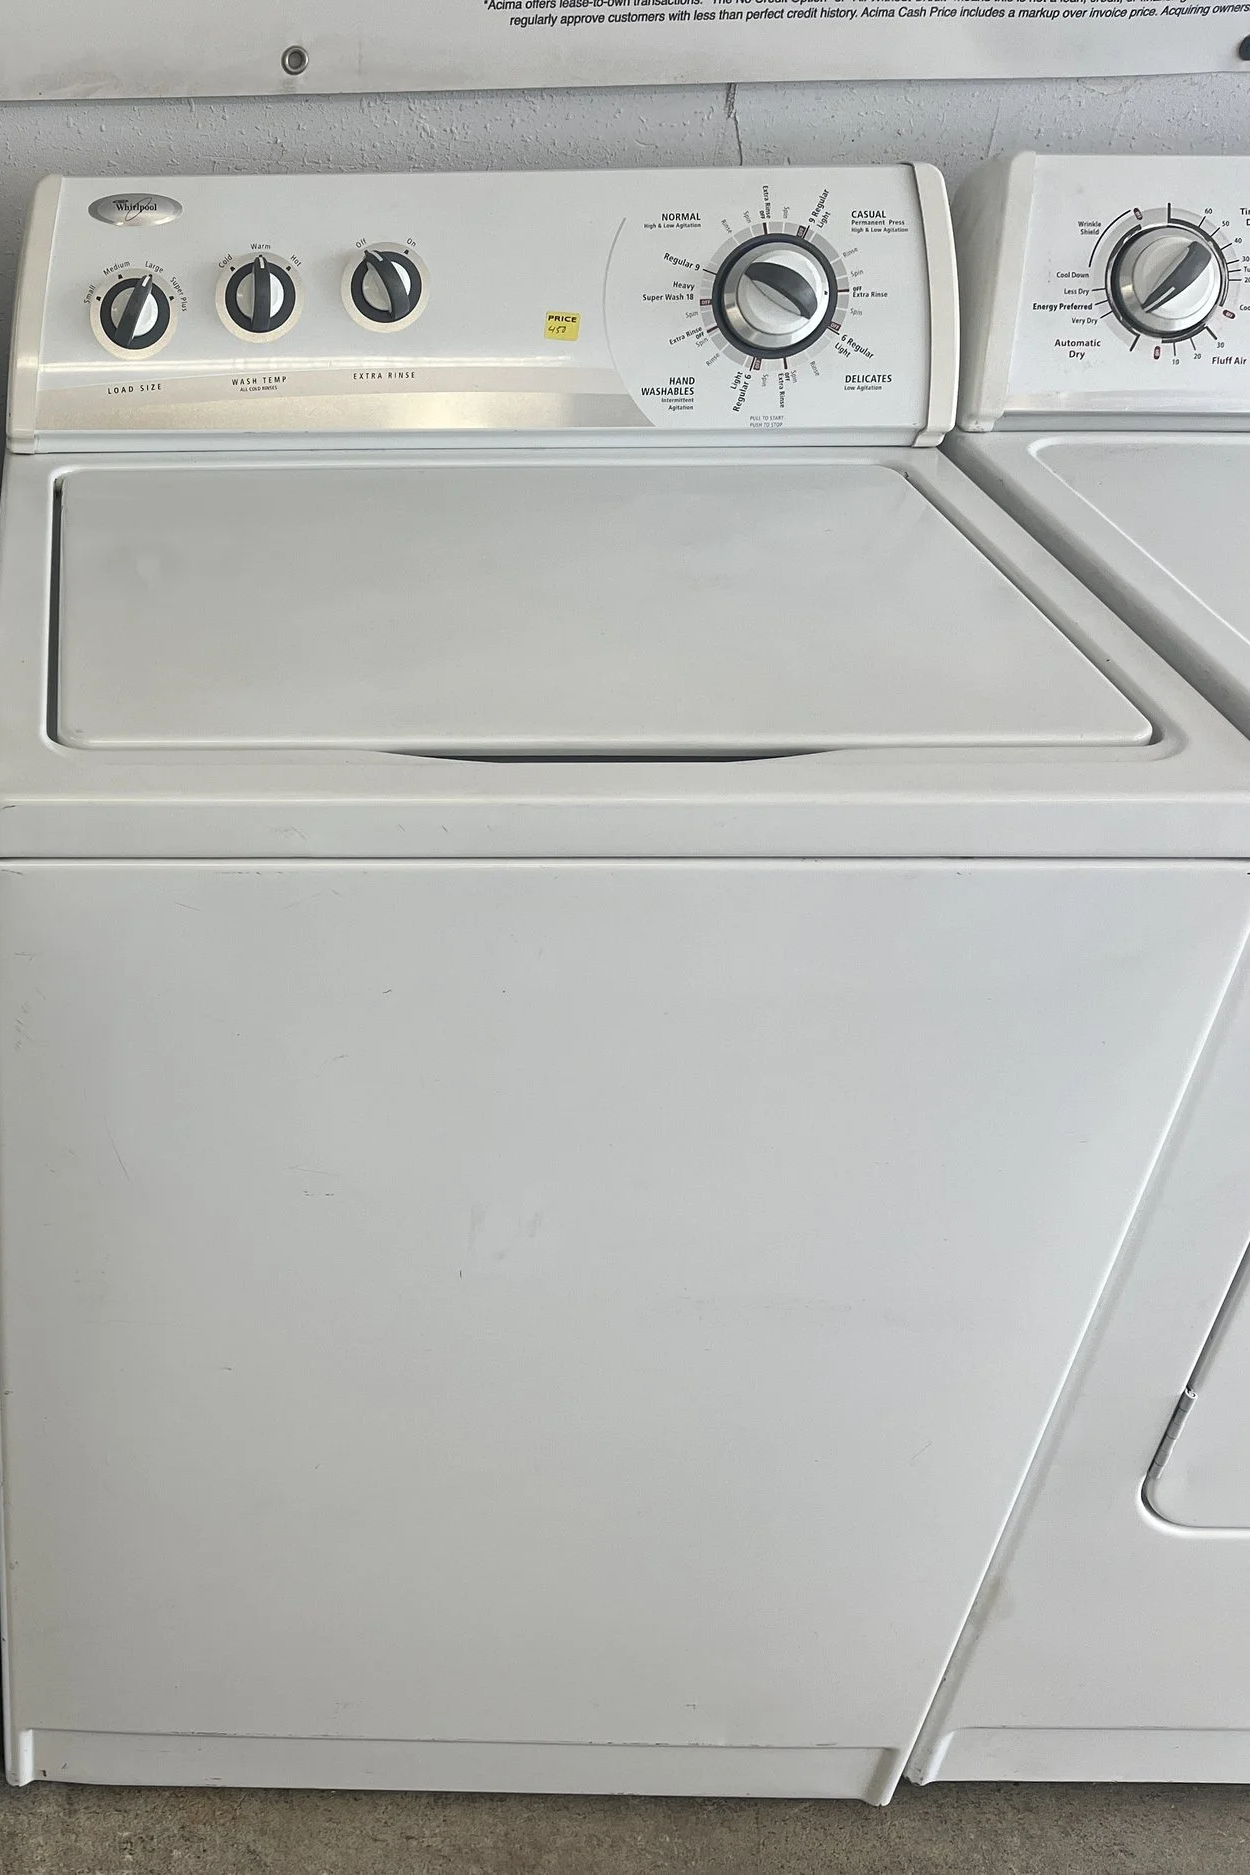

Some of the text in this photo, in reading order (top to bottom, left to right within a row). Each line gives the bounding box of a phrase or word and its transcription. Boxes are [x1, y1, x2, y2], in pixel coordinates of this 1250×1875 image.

[525, 0, 556, 9] offers
[510, 14, 557, 28] regularly
[560, 15, 605, 26] approve
[608, 12, 665, 23] customers
[669, 10, 690, 21] with
[693, 10, 715, 20] less
[719, 9, 743, 20] than
[745, 8, 784, 22] perfect
[786, 8, 817, 19] credit
[820, 7, 858, 20] history.
[861, 7, 895, 18] Acima
[898, 7, 926, 18] Cash
[929, 6, 957, 17] Price
[960, 6, 1005, 17] includes
[1008, 9, 1015, 18] a
[1018, 7, 1059, 20] markup
[1062, 9, 1088, 18] over
[1089, 7, 1127, 18] invoice
[1128, 7, 1158, 19] price.
[1160, 5, 1210, 17] Acquiring
[116, 203, 157, 213] Whirlpool
[812, 189, 830, 217] Regular
[661, 213, 701, 221] NORMAL
[817, 211, 831, 228] Light
[851, 210, 887, 219] CASUAL
[355, 238, 367, 248] Off
[406, 238, 417, 247] On
[218, 254, 233, 269] Cold
[290, 255, 302, 267] Hot
[663, 252, 694, 269] Regular
[103, 260, 131, 276] Medium
[145, 261, 164, 273] Large
[850, 269, 864, 277] Spin
[169, 276, 184, 297] Super
[672, 281, 695, 290] Heavy
[83, 285, 96, 303] Small
[1078, 288, 1090, 296] Dry
[642, 294, 663, 302] Super
[850, 308, 863, 316] Spin
[1032, 303, 1058, 311] Energy
[548, 315, 577, 323] PRICE
[685, 311, 698, 319] Spin
[1086, 317, 1098, 325] Dry
[669, 326, 703, 345] Extra Rinse
[1054, 339, 1101, 347] Automatic
[834, 342, 851, 358] Light
[847, 338, 874, 359] Regular
[1069, 350, 1085, 360] Dry
[1212, 357, 1232, 365] Fluff
[353, 371, 416, 380] EXTRA RINSE
[730, 371, 743, 390] Light
[845, 374, 892, 383] DELICATES
[231, 376, 287, 386] WASH TEMP
[669, 377, 695, 386] HAND
[107, 383, 162, 394] LOAD SIZE
[641, 387, 695, 396] WASHABLES
[732, 380, 749, 412] Regular
